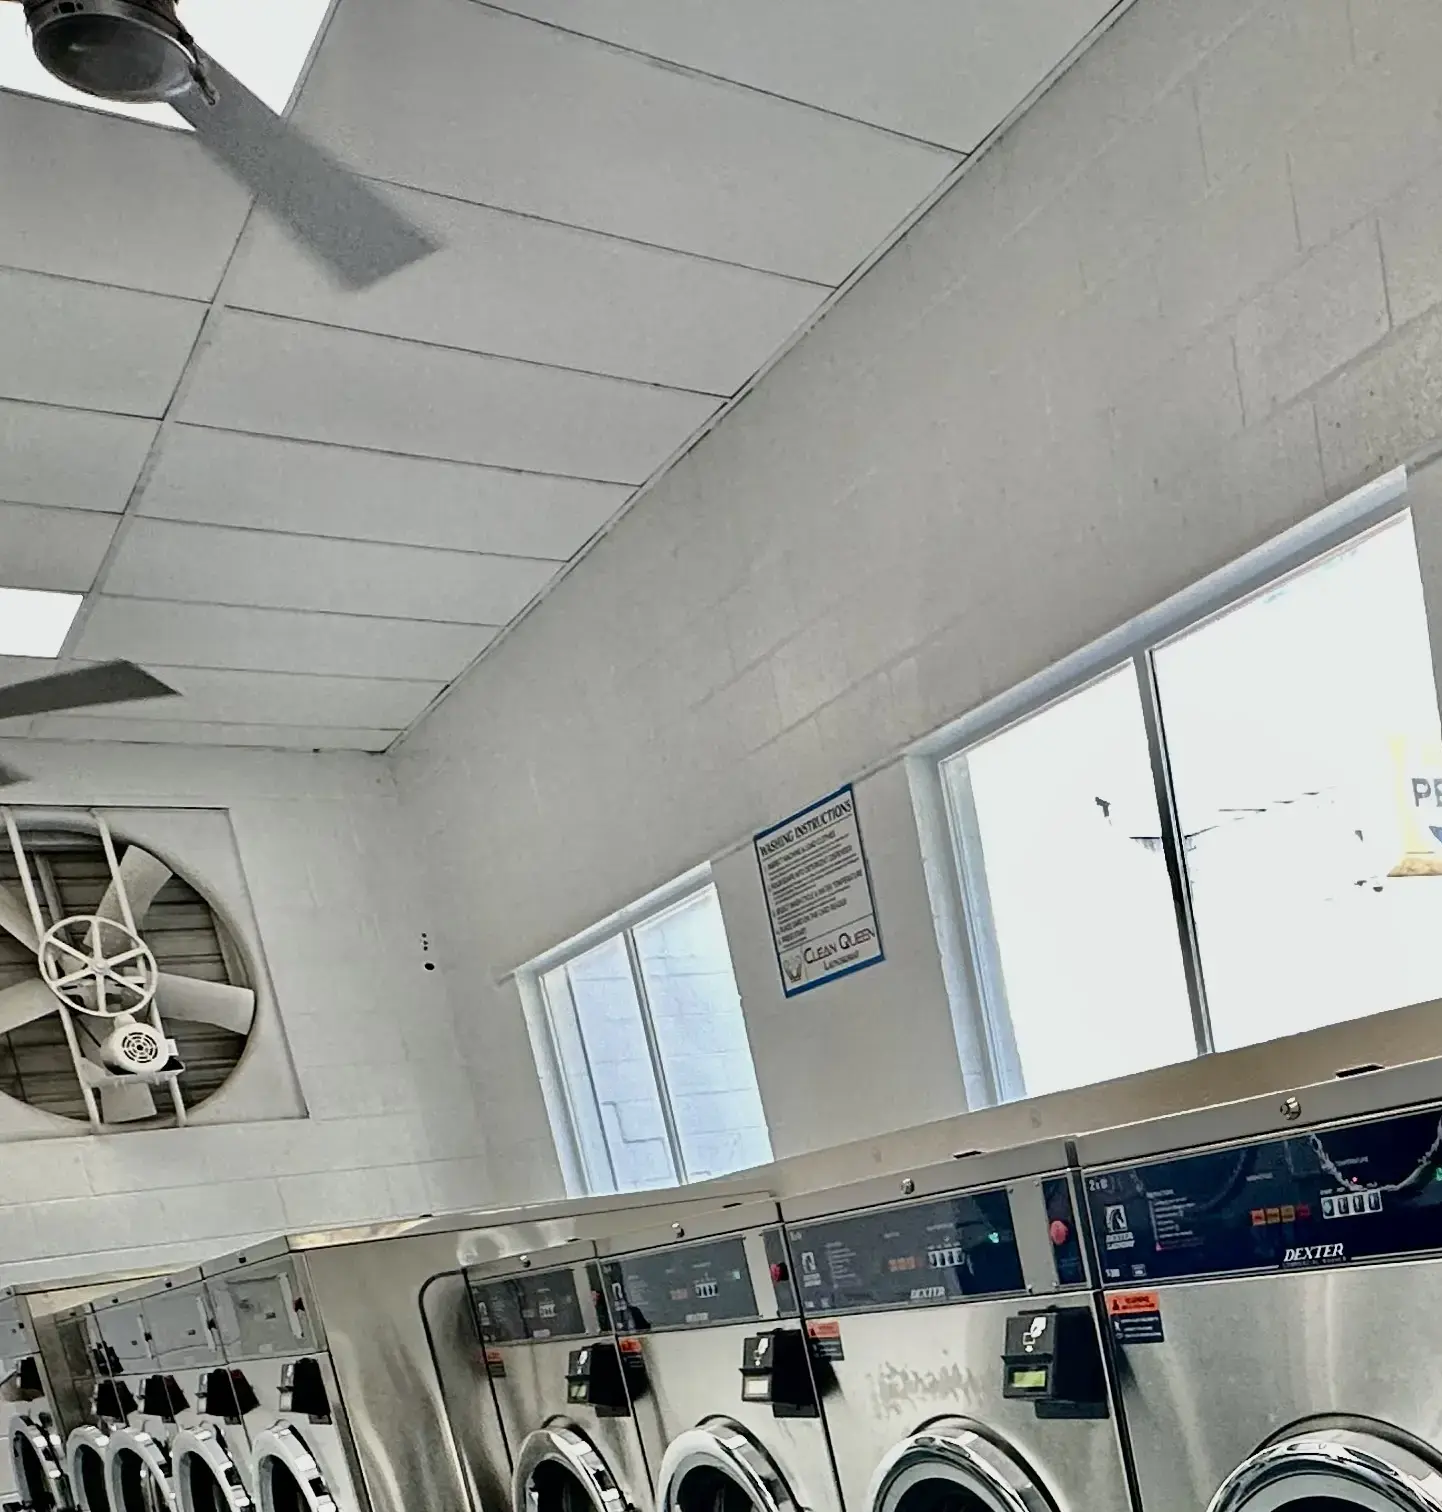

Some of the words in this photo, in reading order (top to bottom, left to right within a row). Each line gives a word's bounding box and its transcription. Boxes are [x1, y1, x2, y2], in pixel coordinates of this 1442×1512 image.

[759, 830, 794, 857] WASHING
[795, 798, 852, 838] INSTRUCTIONS
[1283, 1242, 1345, 1263] DEXTER
